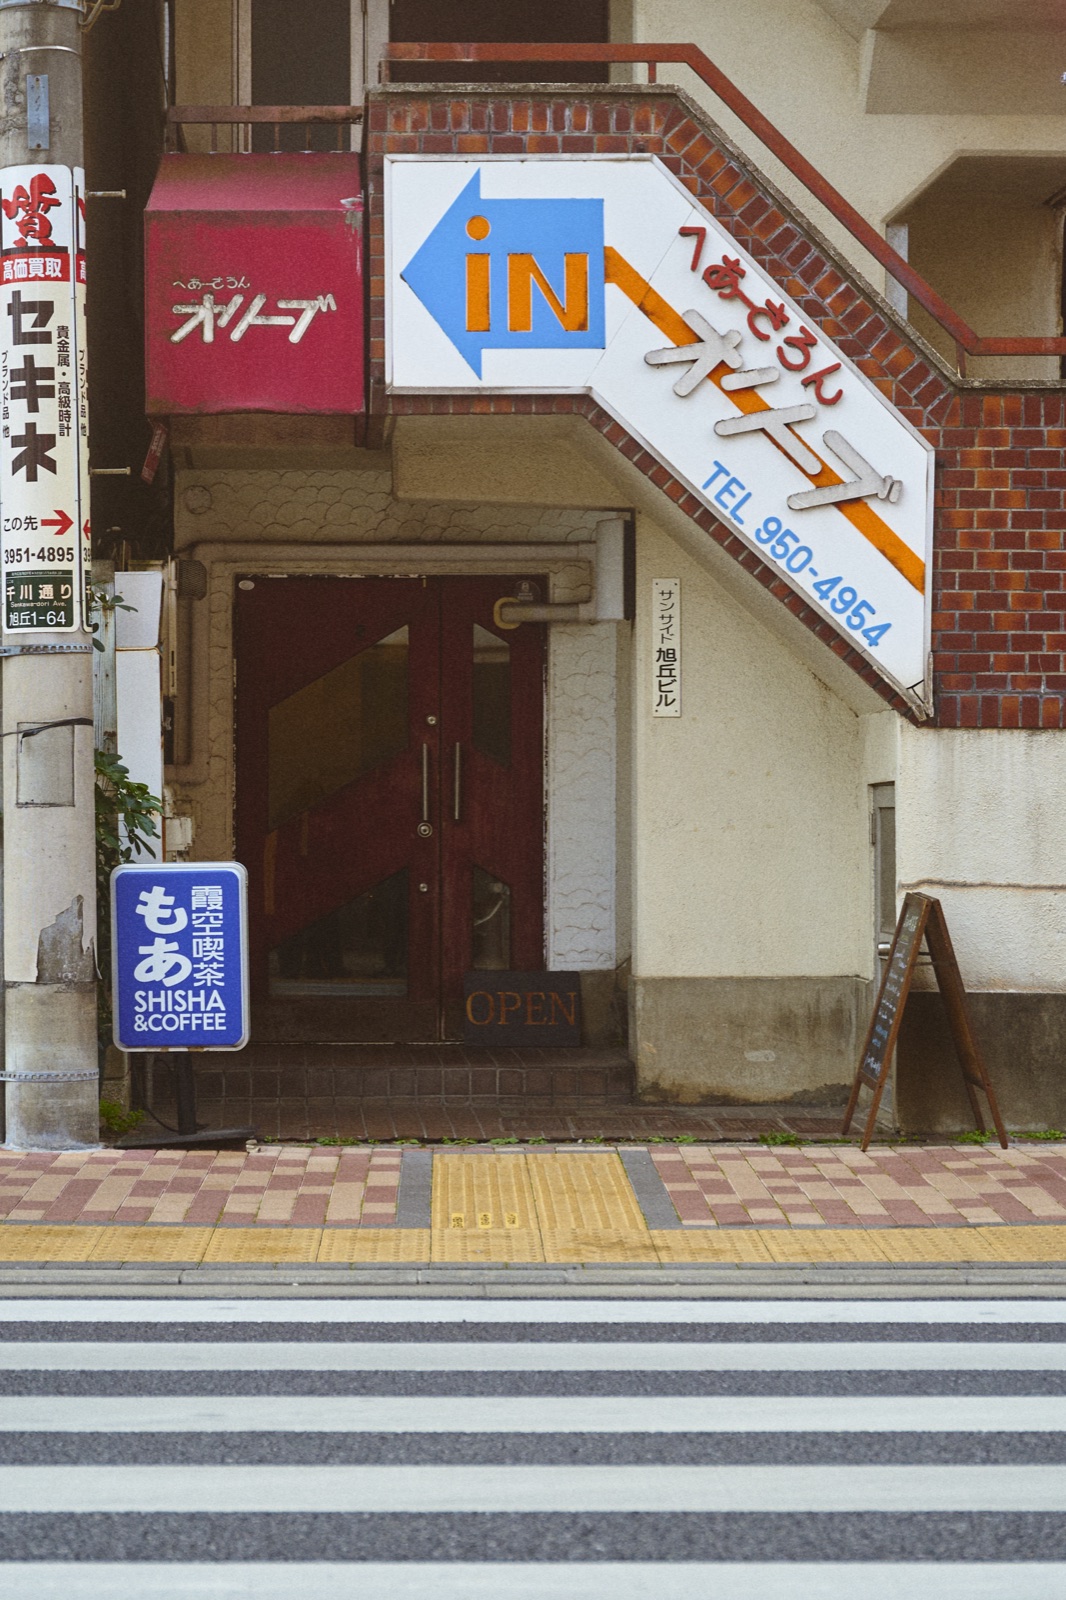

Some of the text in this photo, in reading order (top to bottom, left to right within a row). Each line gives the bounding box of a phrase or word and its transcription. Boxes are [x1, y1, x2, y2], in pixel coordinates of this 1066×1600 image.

[3, 258, 62, 281] 高価買取
[173, 276, 250, 290] へあーさろん
[170, 293, 337, 344] オリーブ
[7, 290, 57, 482] セキネ
[644, 309, 903, 511] オリーブ
[4, 516, 38, 532] この先
[4, 547, 74, 564] 3951-4895
[702, 460, 892, 647] TEL 950-4954
[6, 584, 72, 601] 千川通り
[9, 611, 66, 626] 旭丘1-64
[134, 886, 193, 988] もあ
[191, 885, 225, 987] 霞空喫茶
[134, 990, 226, 1013] SHISHA
[466, 991, 577, 1026] OPEN
[134, 1013, 227, 1032] &COFFEE
